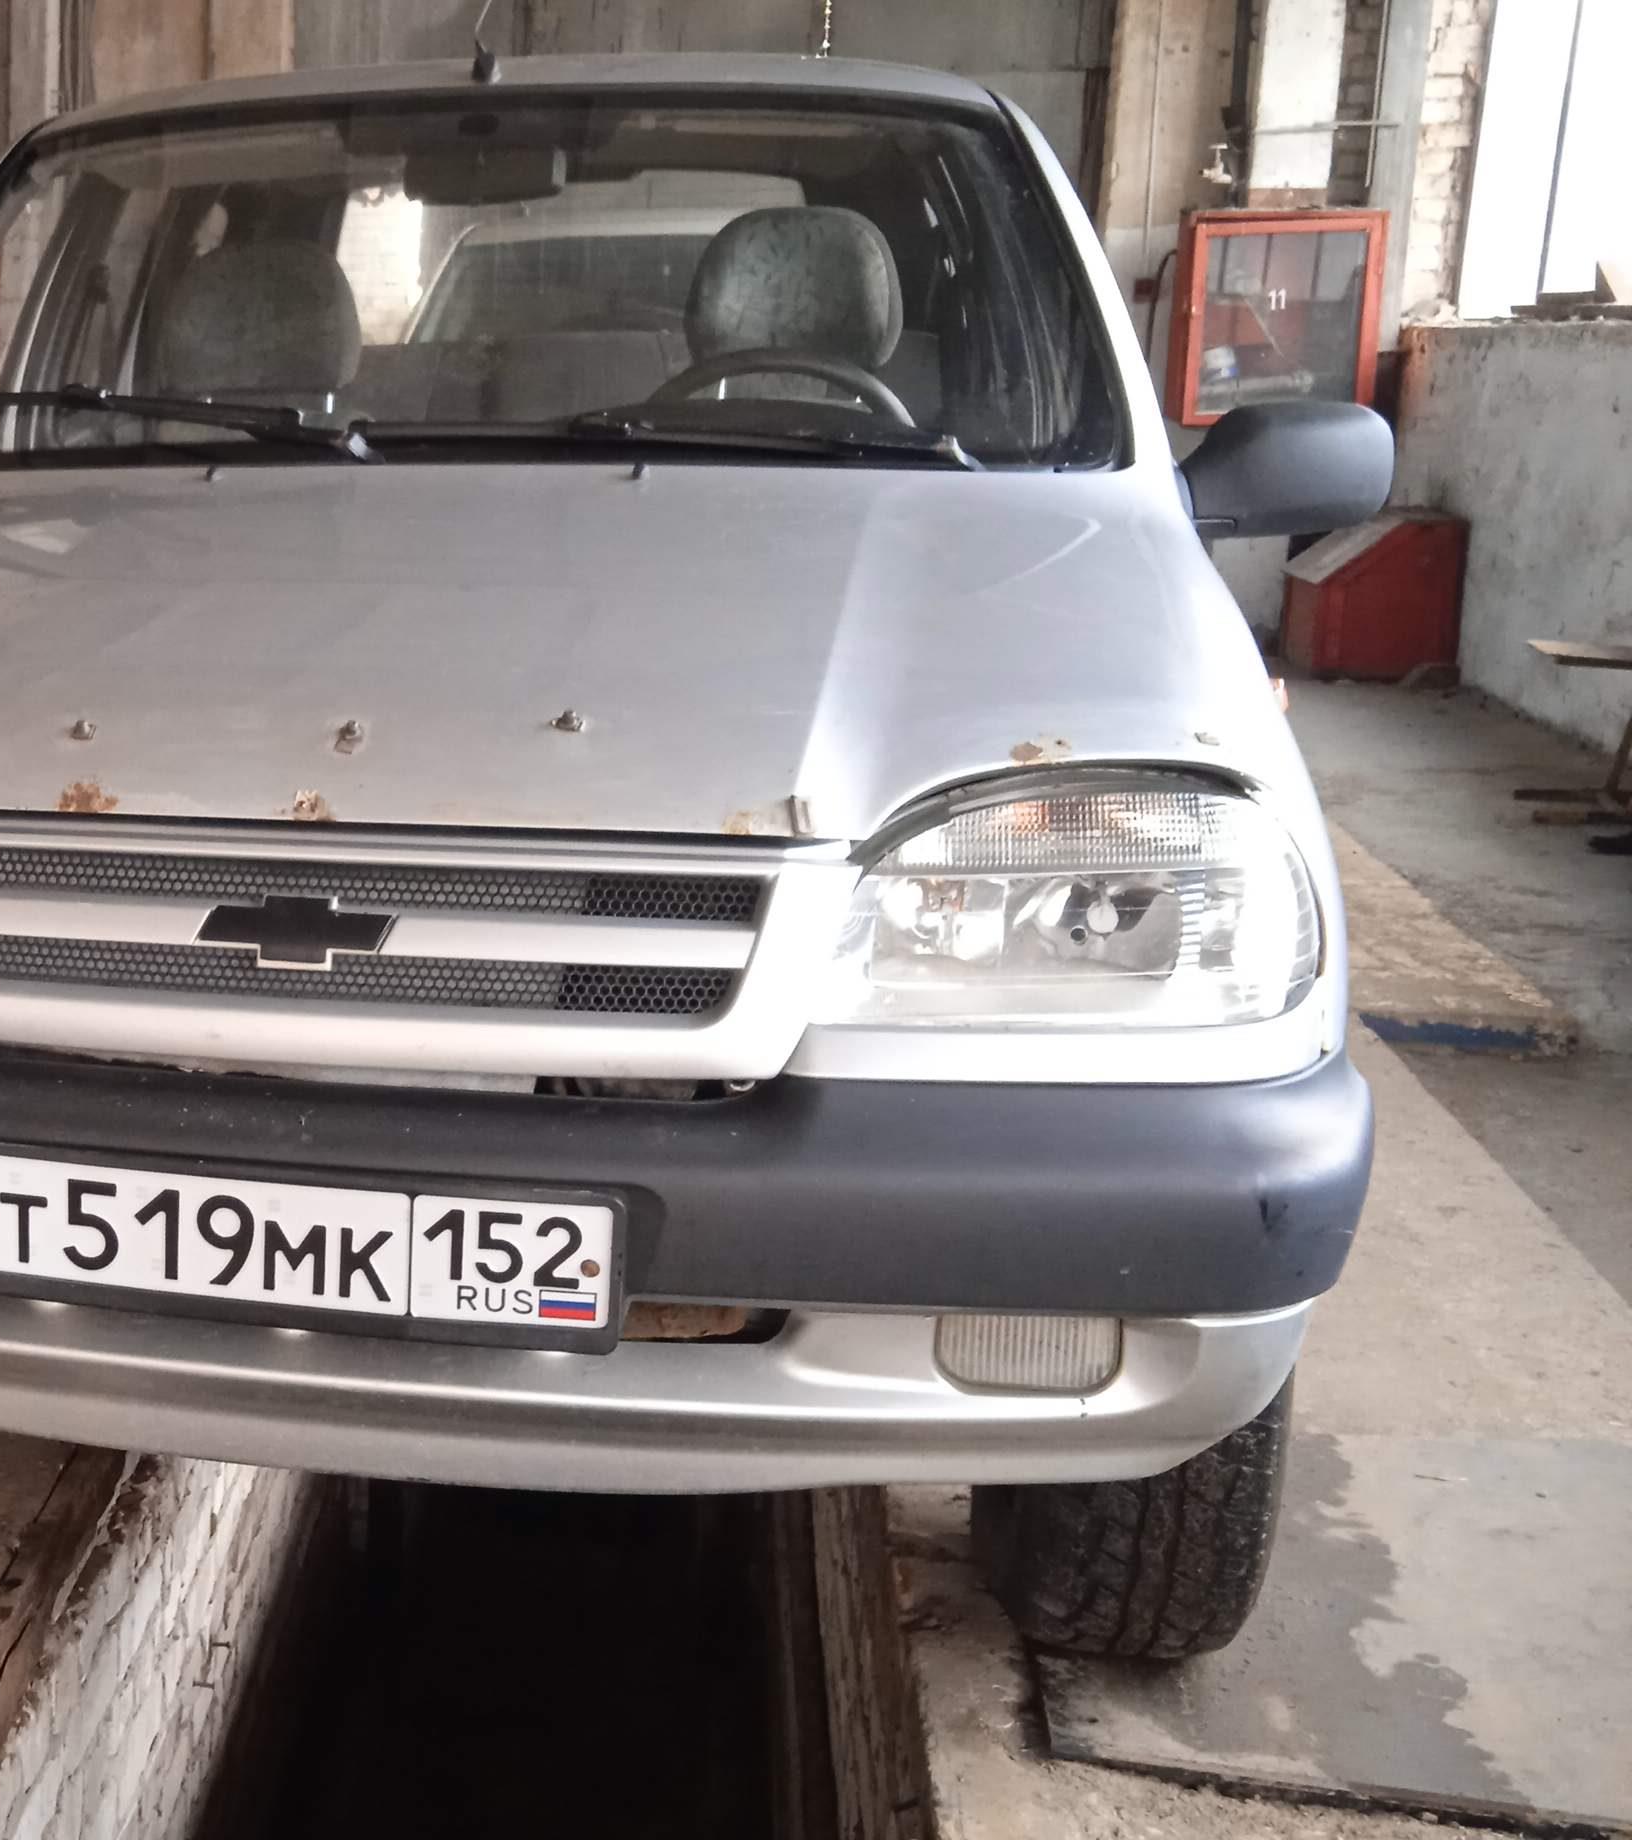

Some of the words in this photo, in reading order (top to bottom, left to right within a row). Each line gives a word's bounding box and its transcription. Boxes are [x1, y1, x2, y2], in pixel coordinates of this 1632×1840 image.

[1267, 287, 1288, 311] 11
[423, 1207, 583, 1290] 152
[456, 1285, 534, 1314] RUS
